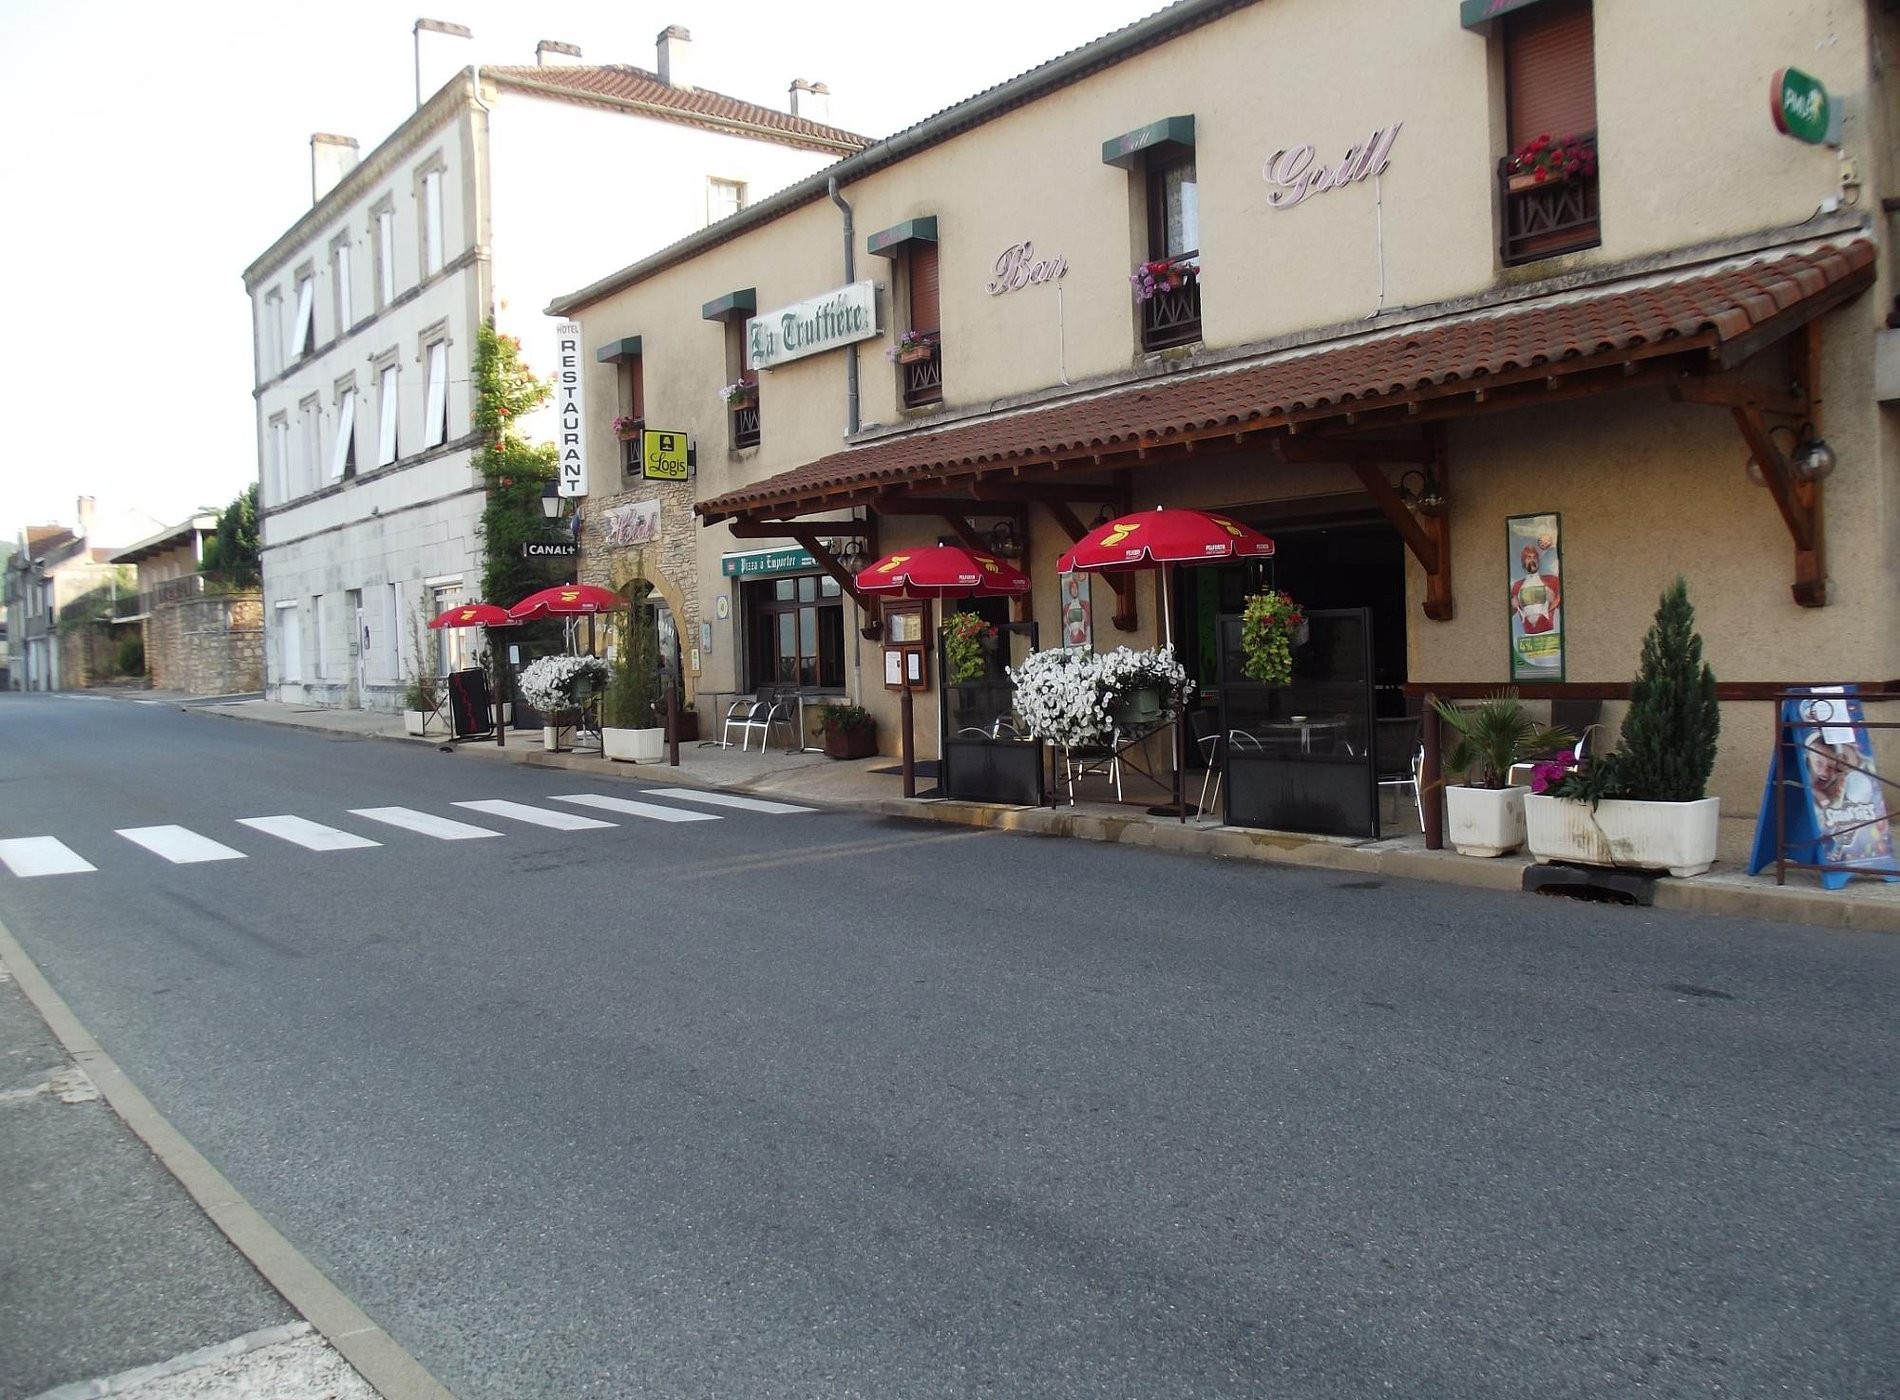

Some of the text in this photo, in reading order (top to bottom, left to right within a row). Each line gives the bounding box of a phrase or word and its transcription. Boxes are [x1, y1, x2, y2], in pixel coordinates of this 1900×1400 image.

[1262, 120, 1405, 210] Grill
[985, 241, 1069, 297] Bar
[556, 324, 579, 335] HOTEL
[750, 294, 863, 362] La Truffière
[561, 339, 581, 492] RESTAURANT
[649, 452, 686, 477] Logis
[528, 544, 576, 555] CANAL+
[741, 558, 758, 574] Pizza
[766, 554, 796, 570] Emporter
